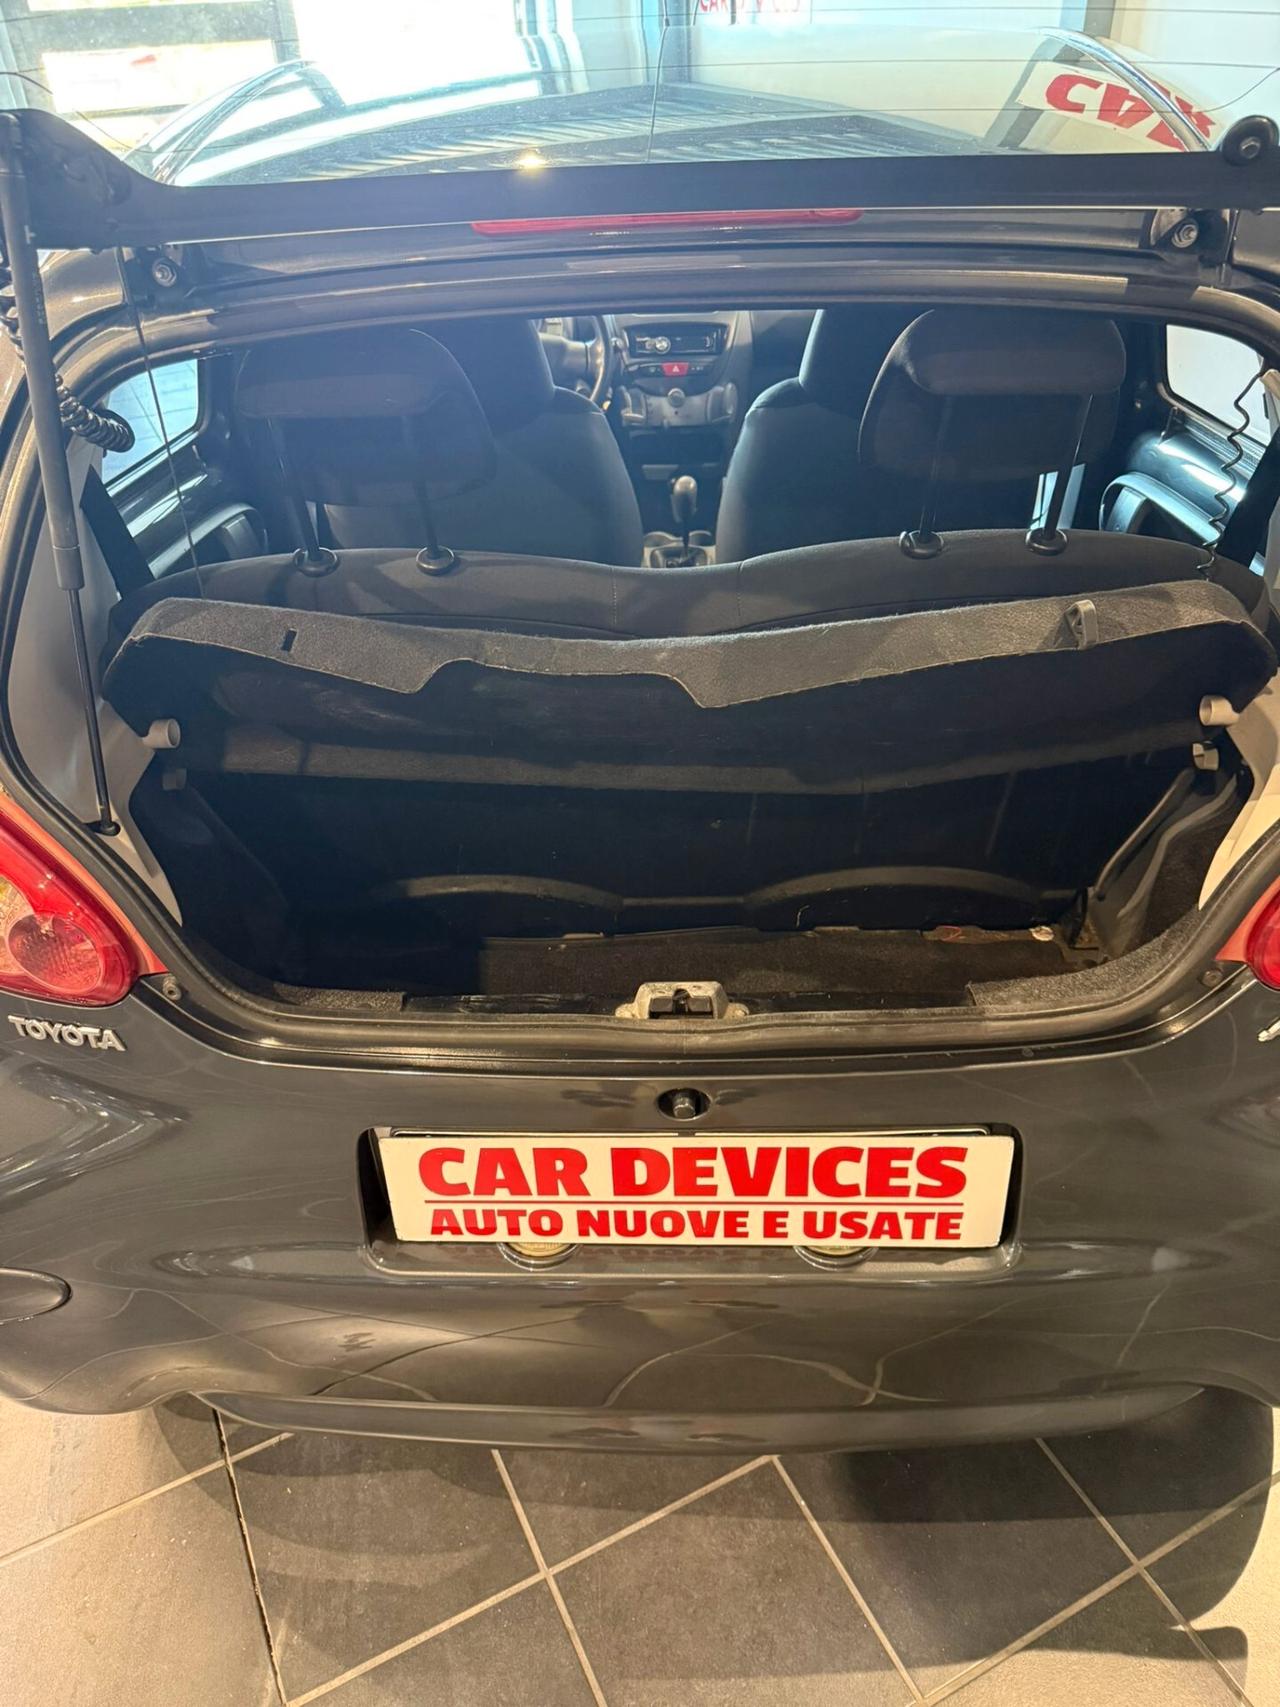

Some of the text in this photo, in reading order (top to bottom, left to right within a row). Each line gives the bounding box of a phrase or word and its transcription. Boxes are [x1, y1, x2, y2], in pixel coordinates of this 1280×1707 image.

[7, 1014, 126, 1052] TOYOTA
[418, 1146, 968, 1199] CAR DEVICES
[430, 1209, 963, 1241] AUTO NUOVE E USATE
